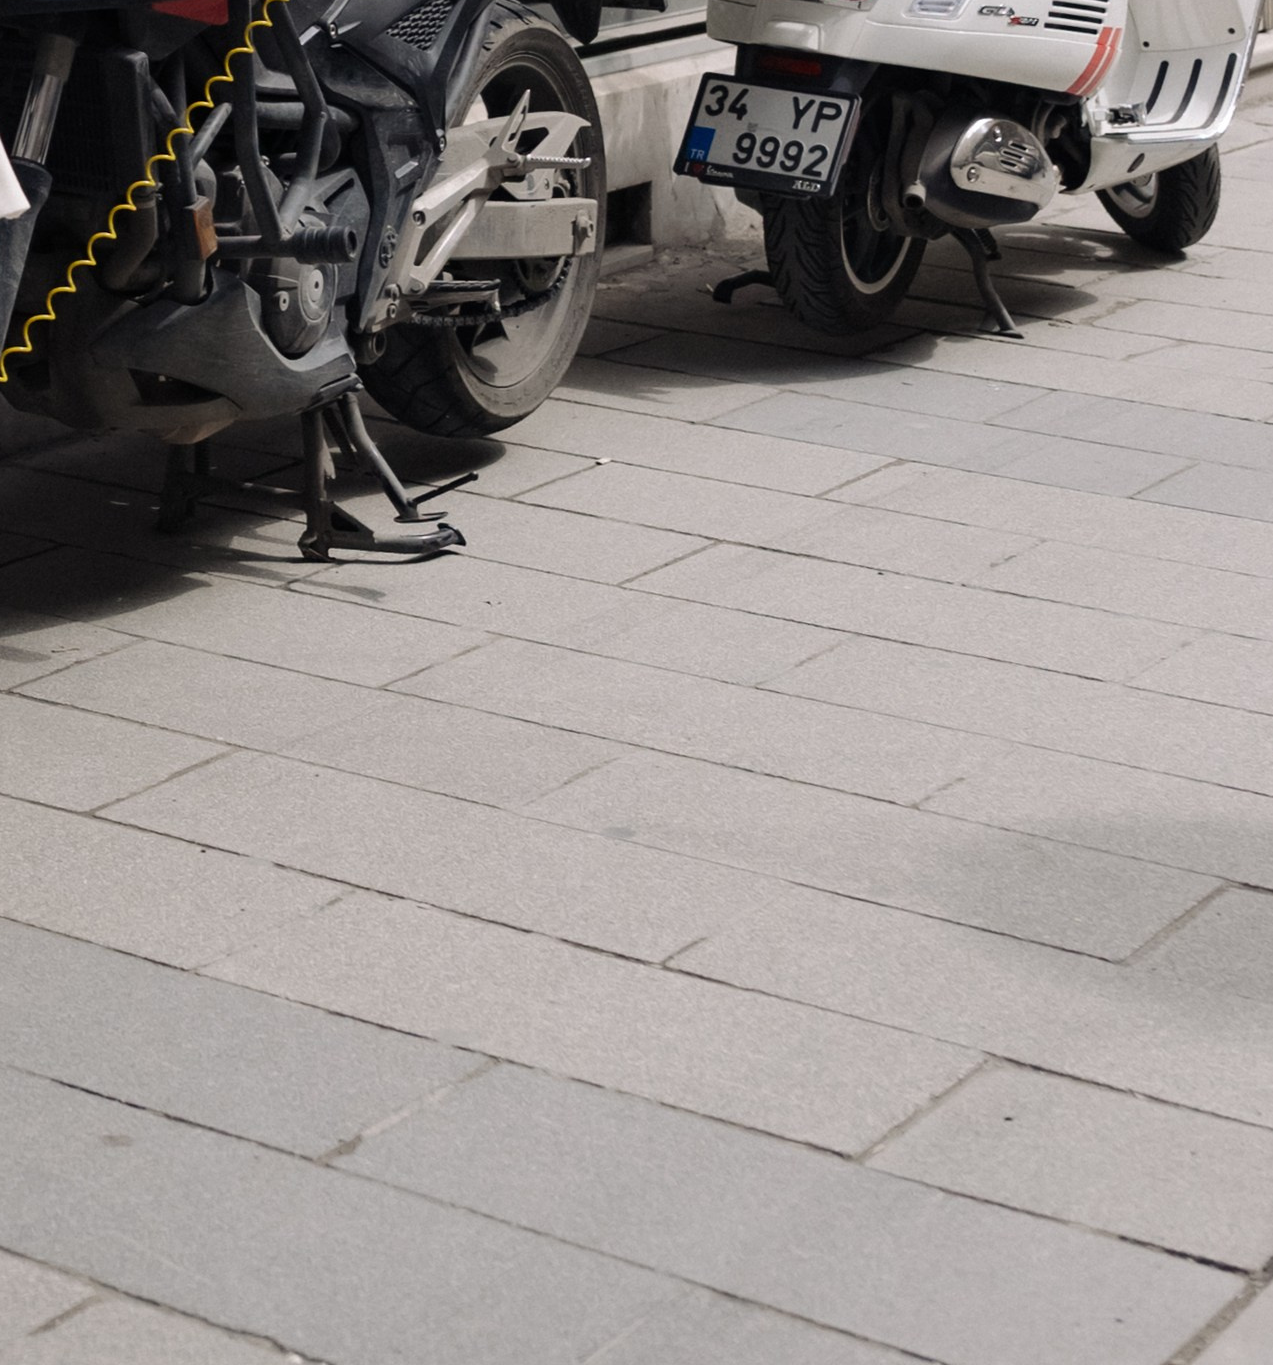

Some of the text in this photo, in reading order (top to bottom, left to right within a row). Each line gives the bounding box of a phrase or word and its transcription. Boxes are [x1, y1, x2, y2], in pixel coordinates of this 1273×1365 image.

[704, 85, 842, 133] 34 YP
[690, 148, 705, 160] TR
[732, 132, 828, 178] 9992
